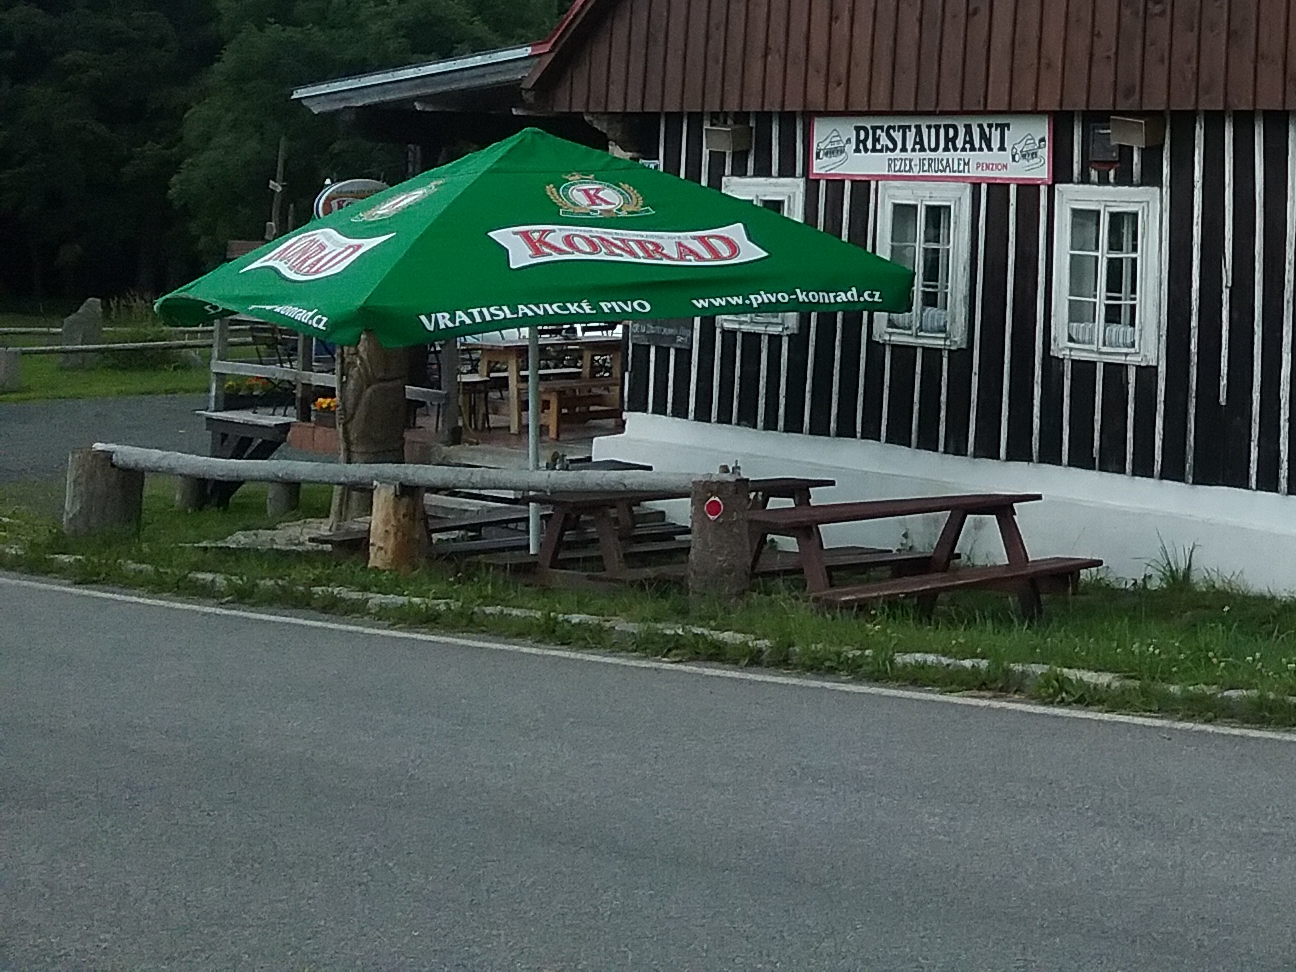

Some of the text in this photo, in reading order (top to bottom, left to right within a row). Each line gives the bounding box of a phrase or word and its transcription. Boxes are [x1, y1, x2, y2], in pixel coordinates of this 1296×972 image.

[853, 122, 1011, 155] RESTAURANT
[887, 157, 1009, 174] REZEK-JERUSALEM PENZION
[575, 187, 617, 207] K
[513, 228, 741, 263] KONRAD
[691, 287, 883, 309] www.pivo-konrad.cz
[419, 299, 652, 332] VRATISLAVICKÉ PIVO
